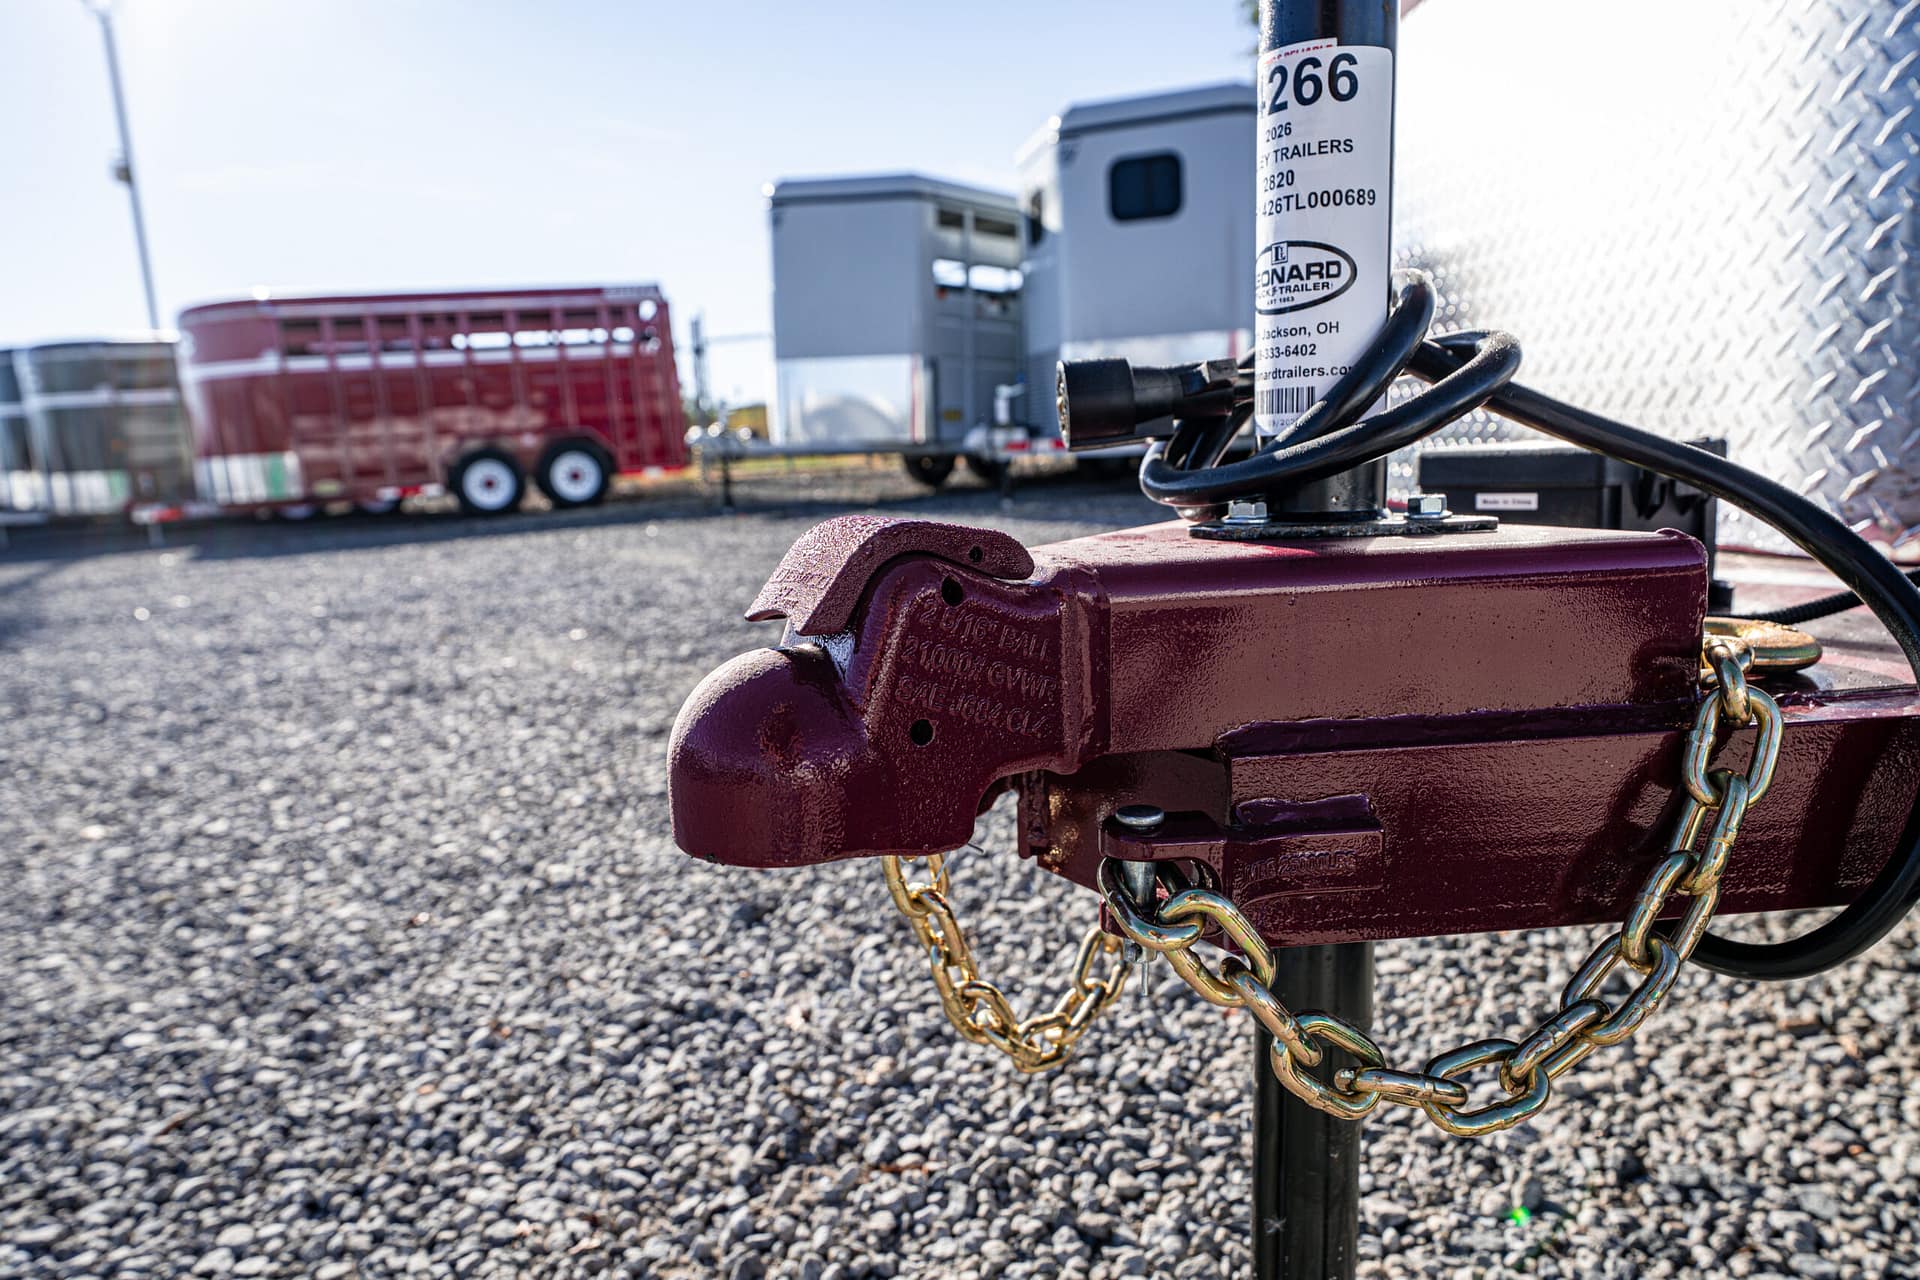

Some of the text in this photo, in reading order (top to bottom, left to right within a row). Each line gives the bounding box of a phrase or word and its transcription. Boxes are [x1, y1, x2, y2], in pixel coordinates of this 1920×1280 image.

[1266, 122, 1292, 142] 2026
[1274, 139, 1354, 163] TRAILERS
[1264, 170, 1294, 192] 2820
[1279, 282, 1330, 294] TRAILER
[1262, 321, 1339, 340] Jackson, OH
[920, 598, 937, 624] 2
[998, 624, 1048, 660] BALL
[988, 661, 1057, 700] GVWR
[896, 675, 948, 710] SAE
